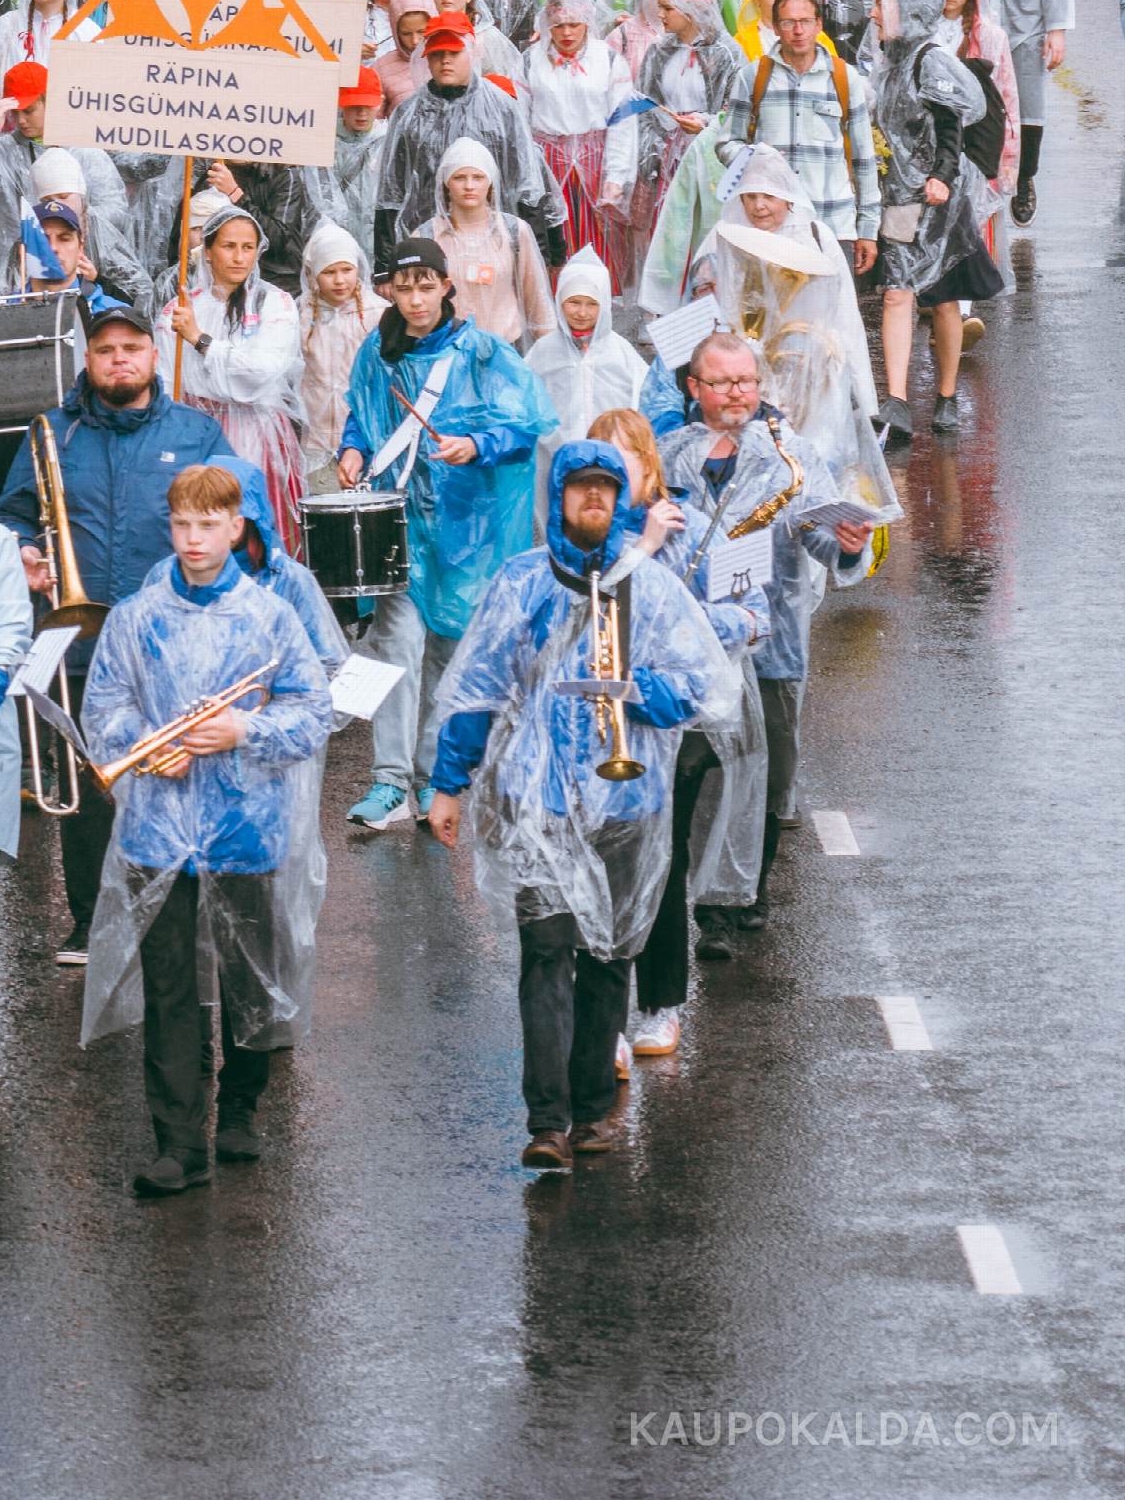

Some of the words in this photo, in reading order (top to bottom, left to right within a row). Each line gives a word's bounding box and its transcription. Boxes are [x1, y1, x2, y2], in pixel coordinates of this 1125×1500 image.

[146, 60, 240, 90] RÄPINA
[67, 86, 316, 129] ÜHISGÜMNAASIUMI
[95, 125, 284, 158] MUDILASKOOR
